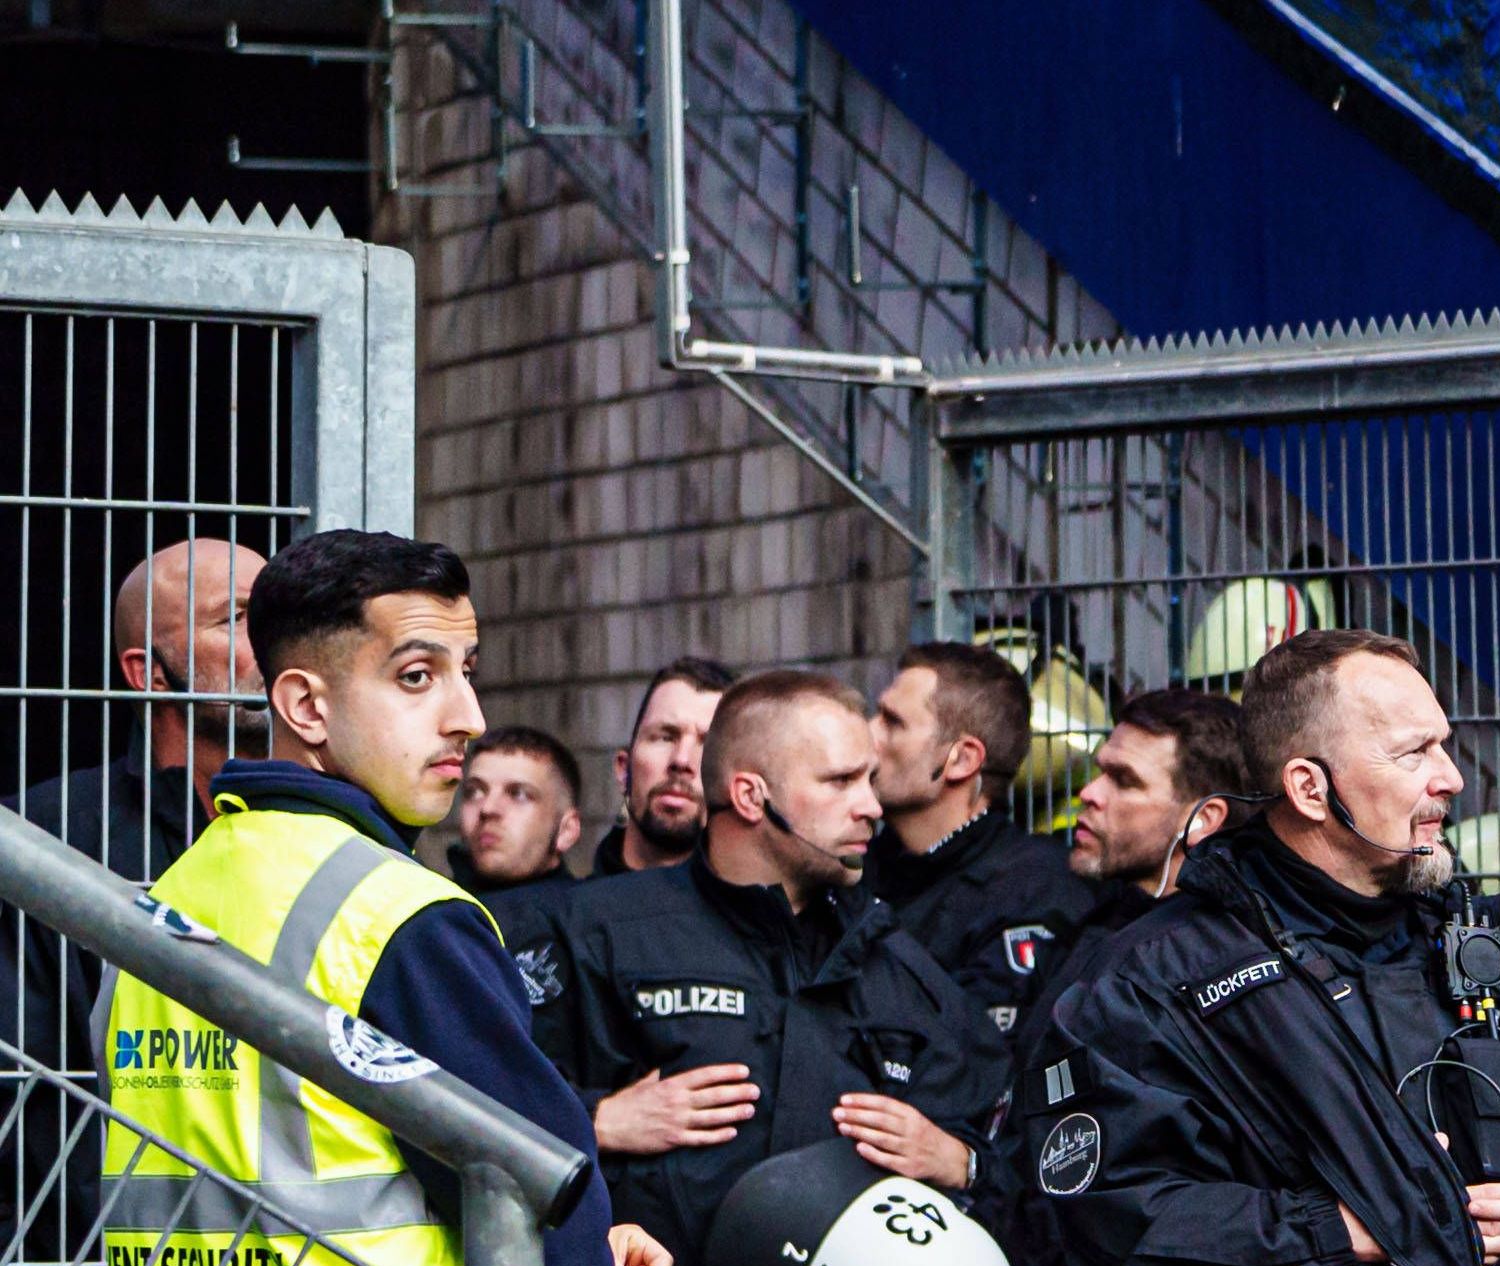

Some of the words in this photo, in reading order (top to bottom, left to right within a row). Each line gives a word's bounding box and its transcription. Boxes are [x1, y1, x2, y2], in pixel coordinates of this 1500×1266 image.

[634, 986, 745, 1018] POLIZEI
[1197, 960, 1280, 1008] LÜCKFETT
[149, 1028, 240, 1070] POWER
